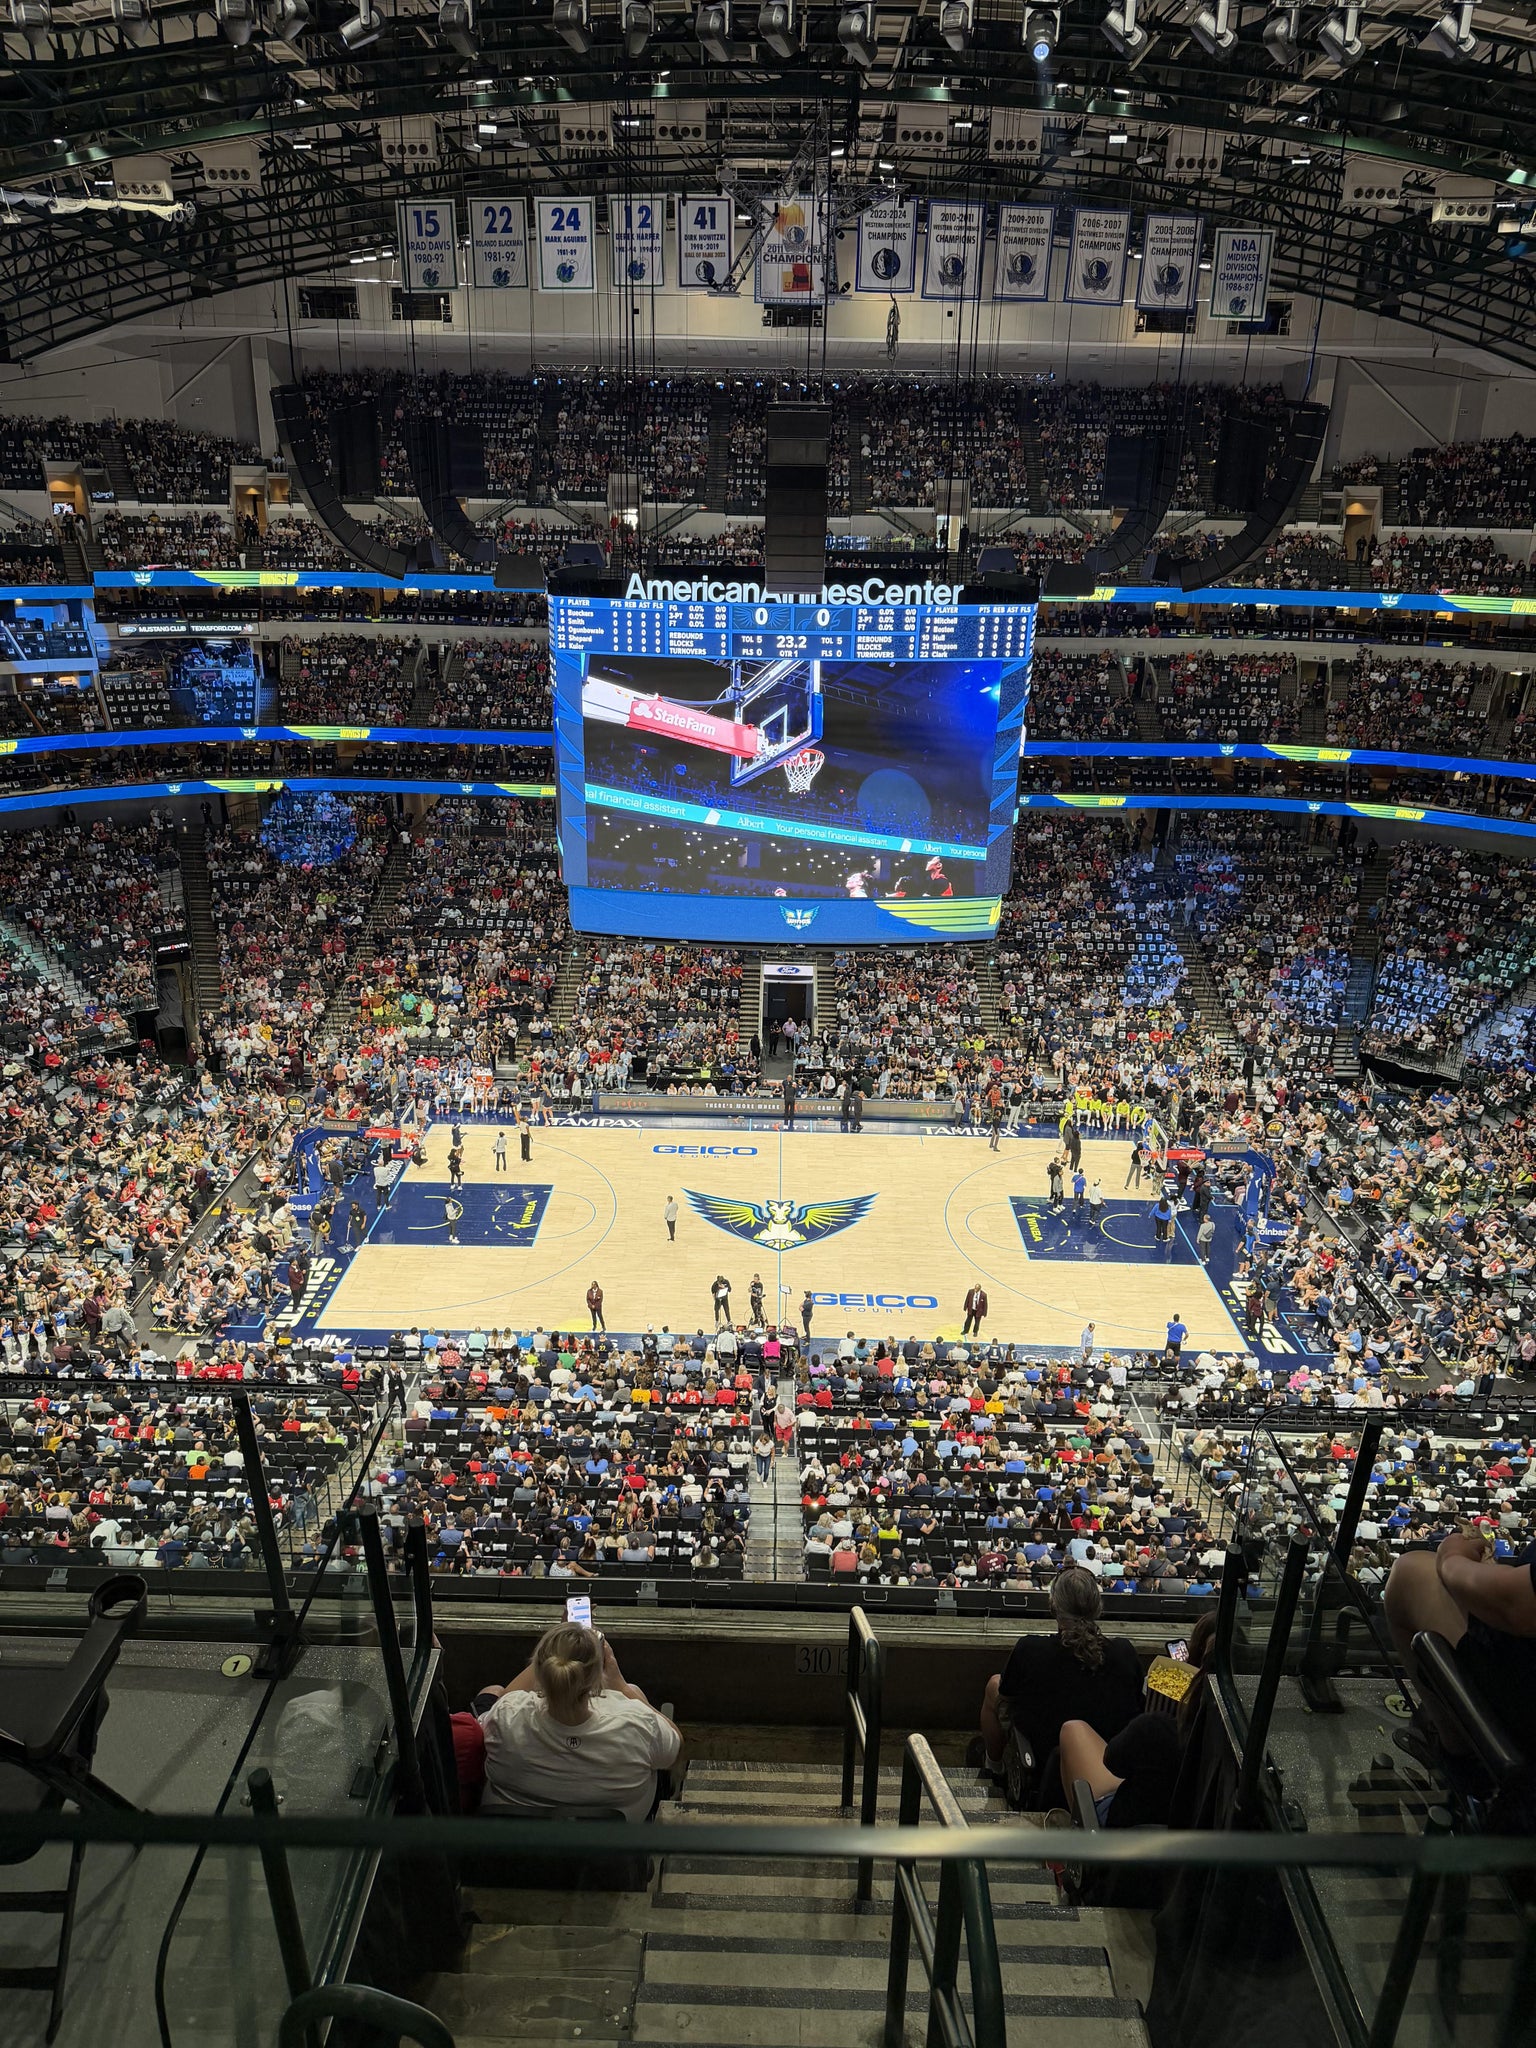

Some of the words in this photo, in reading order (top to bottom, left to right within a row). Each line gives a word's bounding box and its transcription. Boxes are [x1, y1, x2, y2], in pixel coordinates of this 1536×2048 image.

[484, 206, 512, 233] 22
[551, 208, 580, 231] 24
[624, 205, 651, 228] 12
[694, 207, 716, 230] 41
[870, 210, 906, 218] 2023-2024
[1008, 215, 1044, 224] 2009-2010
[413, 210, 440, 237] 15
[1082, 219, 1122, 229] 2006-2007
[1155, 226, 1195, 235] 2005-2006
[868, 232, 907, 241] CHAMPIONS
[936, 235, 975, 244] CHAMPIONS
[1004, 236, 1045, 246] CHAMPIONS
[428, 241, 451, 250] DAVIS
[1080, 240, 1121, 251] CHAMPIONS
[1232, 239, 1256, 251] NBA
[484, 252, 516, 262] 1981-92
[1152, 247, 1194, 256] CHAMPIONS
[414, 254, 444, 263] 1980-92
[1226, 263, 1258, 271] DIVISION
[1220, 273, 1263, 281] CHAMPIONS
[1225, 283, 1254, 291] 1986-87
[755, 607, 768, 625] 0
[817, 608, 830, 626] 0
[669, 632, 704, 640] REBOUNDS
[776, 635, 807, 648] 23.2
[654, 708, 716, 736] StateFarm
[600, 792, 642, 808] financial
[644, 800, 686, 816] assistant
[737, 817, 764, 829] Albert
[776, 823, 794, 834] Your
[795, 827, 826, 840] personal
[828, 830, 858, 843] financial
[858, 836, 888, 846] assistant
[923, 844, 942, 853] Albert
[950, 847, 962, 855] Your
[548, 1118, 642, 1128] TAMPAX
[653, 1145, 758, 1156] GEICO
[520, 1200, 538, 1224] WNBA
[1027, 1218, 1043, 1242] WNBA
[306, 1267, 342, 1317] DALLAS
[812, 1292, 938, 1309] GEICO
[232, 1660, 240, 1672] 1
[798, 1647, 832, 1674] 310
